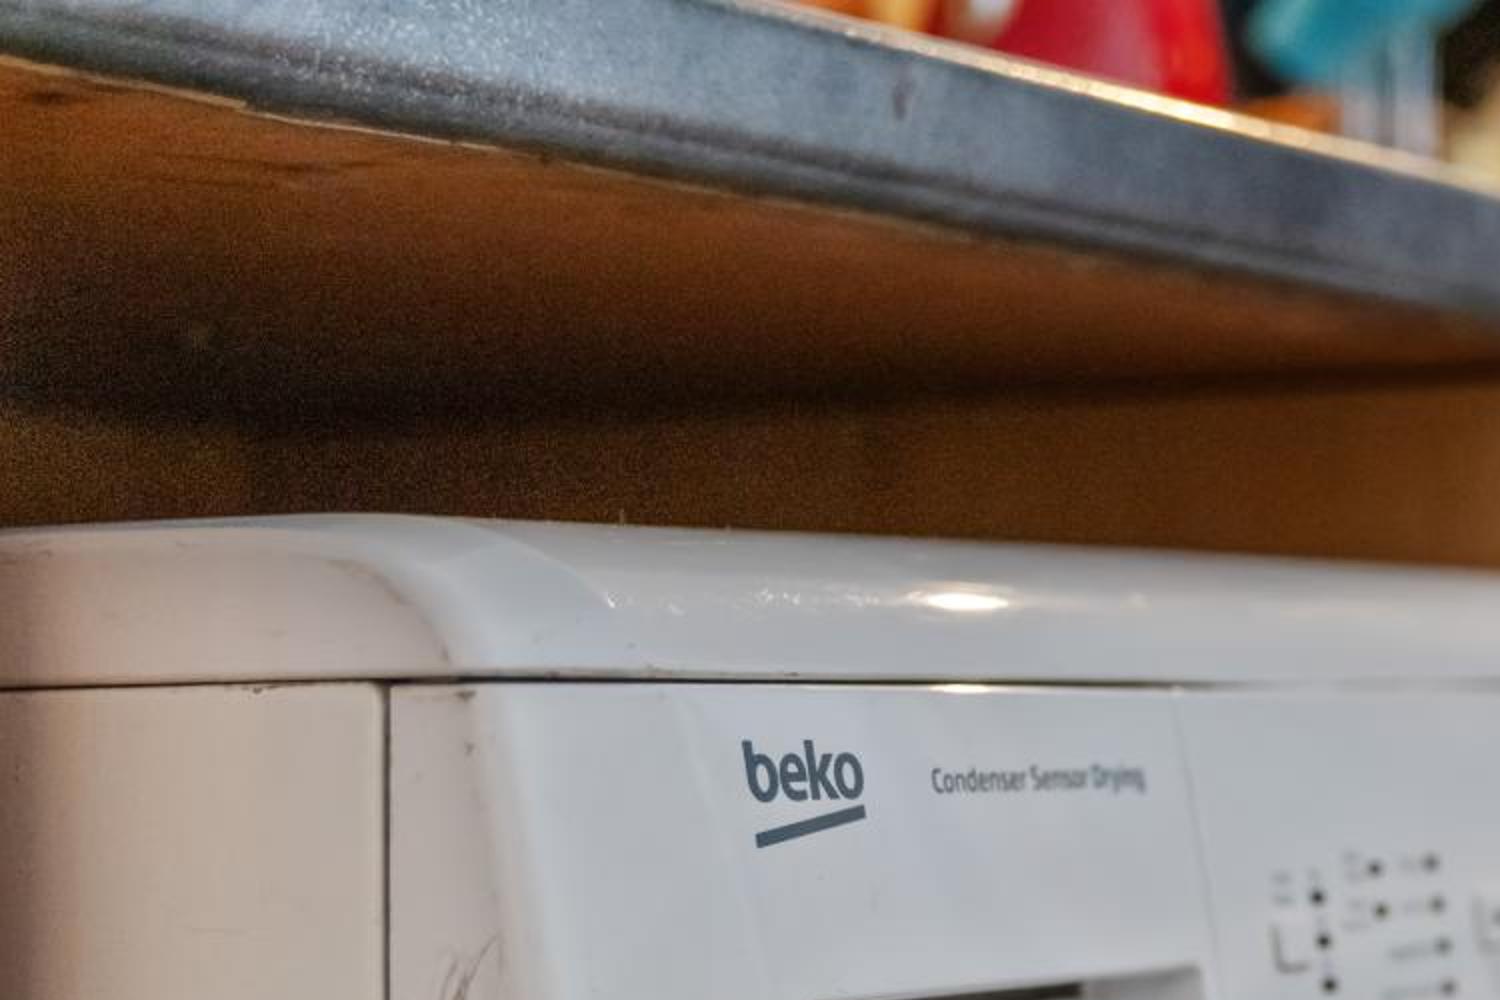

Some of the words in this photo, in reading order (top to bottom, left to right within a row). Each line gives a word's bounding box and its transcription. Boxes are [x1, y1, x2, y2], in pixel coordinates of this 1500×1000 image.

[742, 740, 864, 802] beko
[931, 767, 1026, 795] Condenser
[1029, 765, 1087, 791] Sensor
[1091, 763, 1147, 795] Drying
